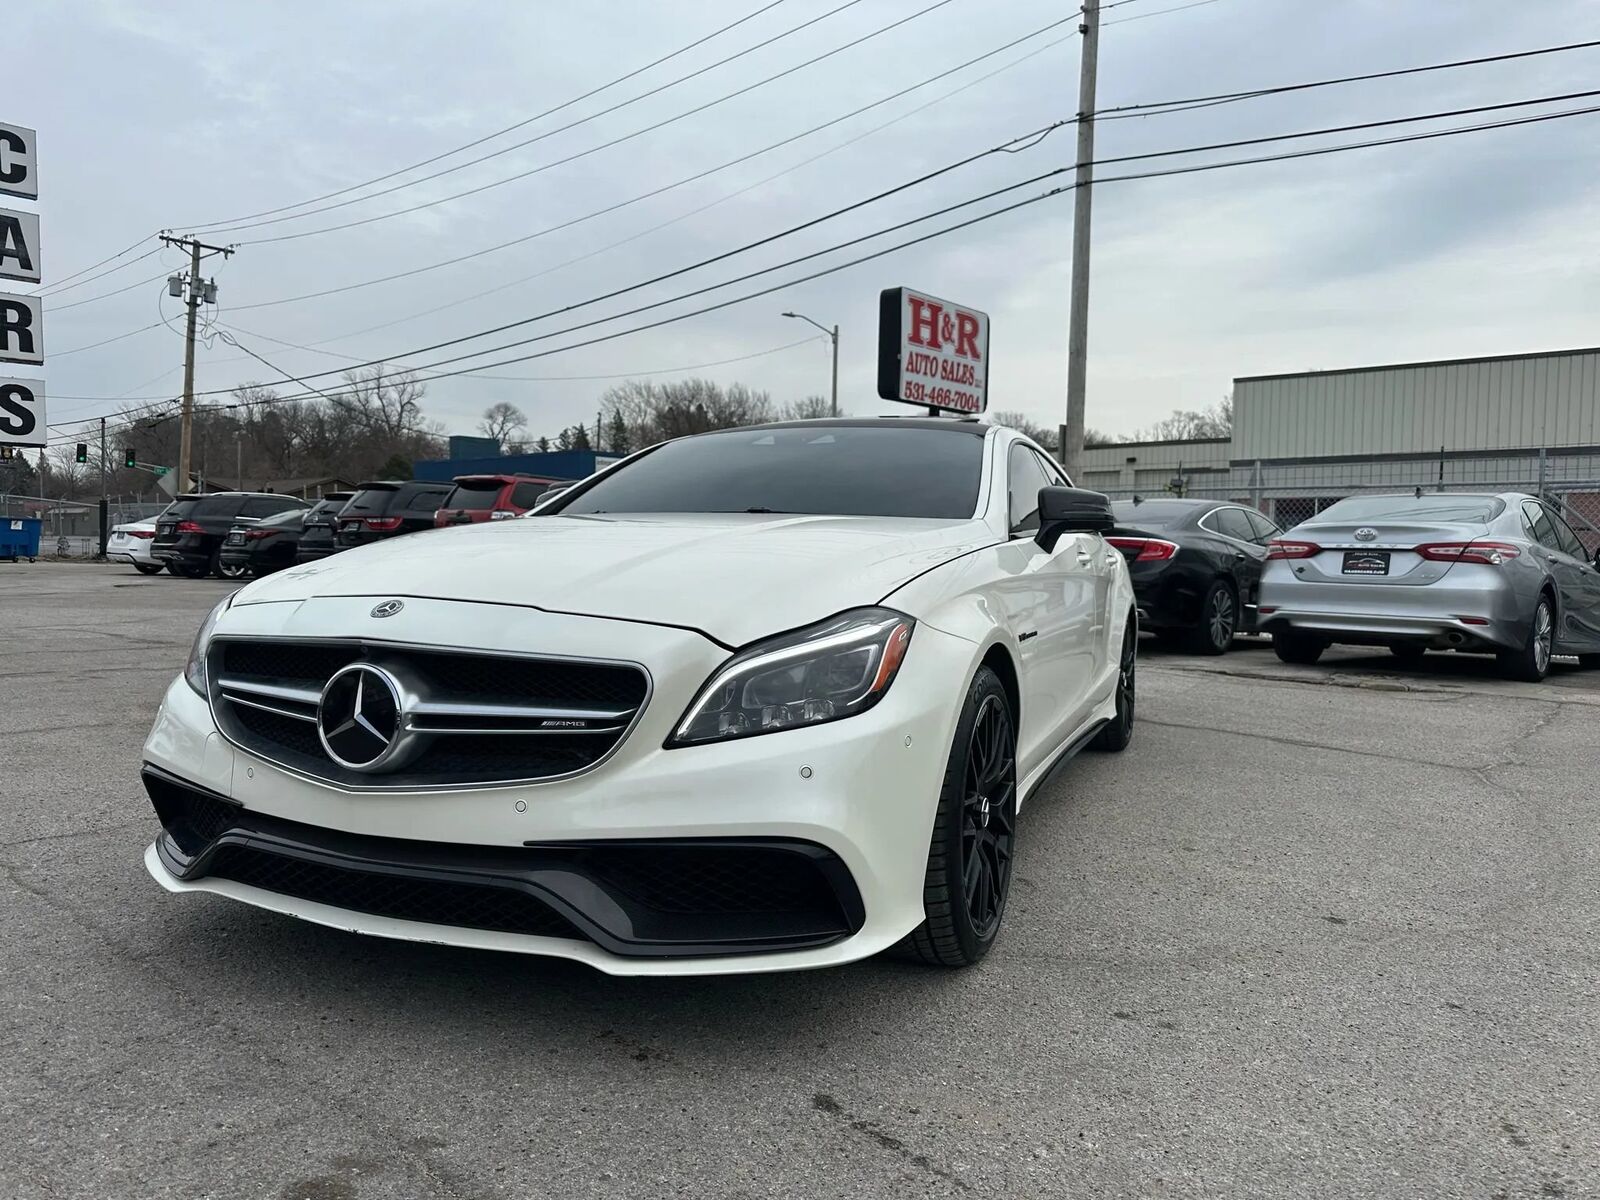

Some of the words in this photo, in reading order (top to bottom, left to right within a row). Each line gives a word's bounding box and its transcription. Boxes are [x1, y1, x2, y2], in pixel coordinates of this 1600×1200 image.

[907, 296, 982, 361] H&R
[905, 351, 938, 378] AUTO
[941, 358, 975, 386] SALES
[904, 381, 981, 411] 531-466-7004
